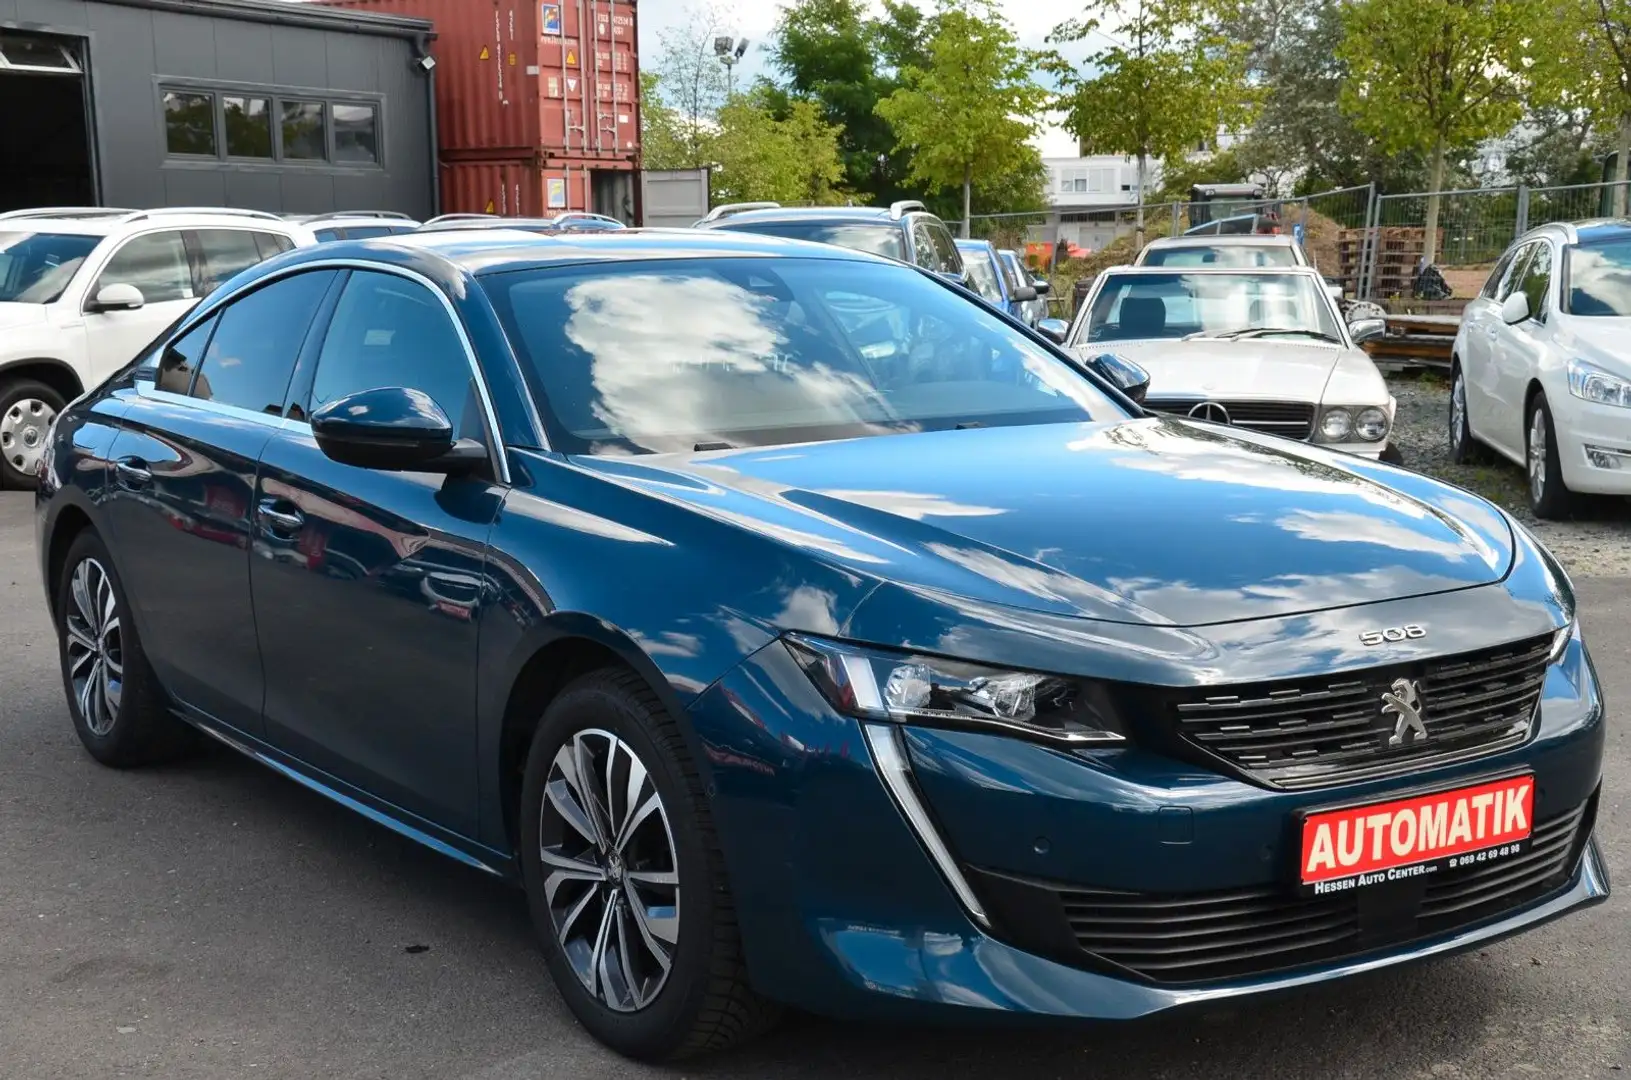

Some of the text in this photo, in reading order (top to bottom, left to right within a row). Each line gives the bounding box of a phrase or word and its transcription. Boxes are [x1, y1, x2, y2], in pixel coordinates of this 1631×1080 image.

[1359, 623, 1427, 646] 508
[1306, 784, 1531, 872] AUTOMATIK
[1459, 843, 1520, 866] 069 42 69 48 98
[1314, 878, 1356, 895] HESSEN
[1357, 872, 1386, 887] AUTO
